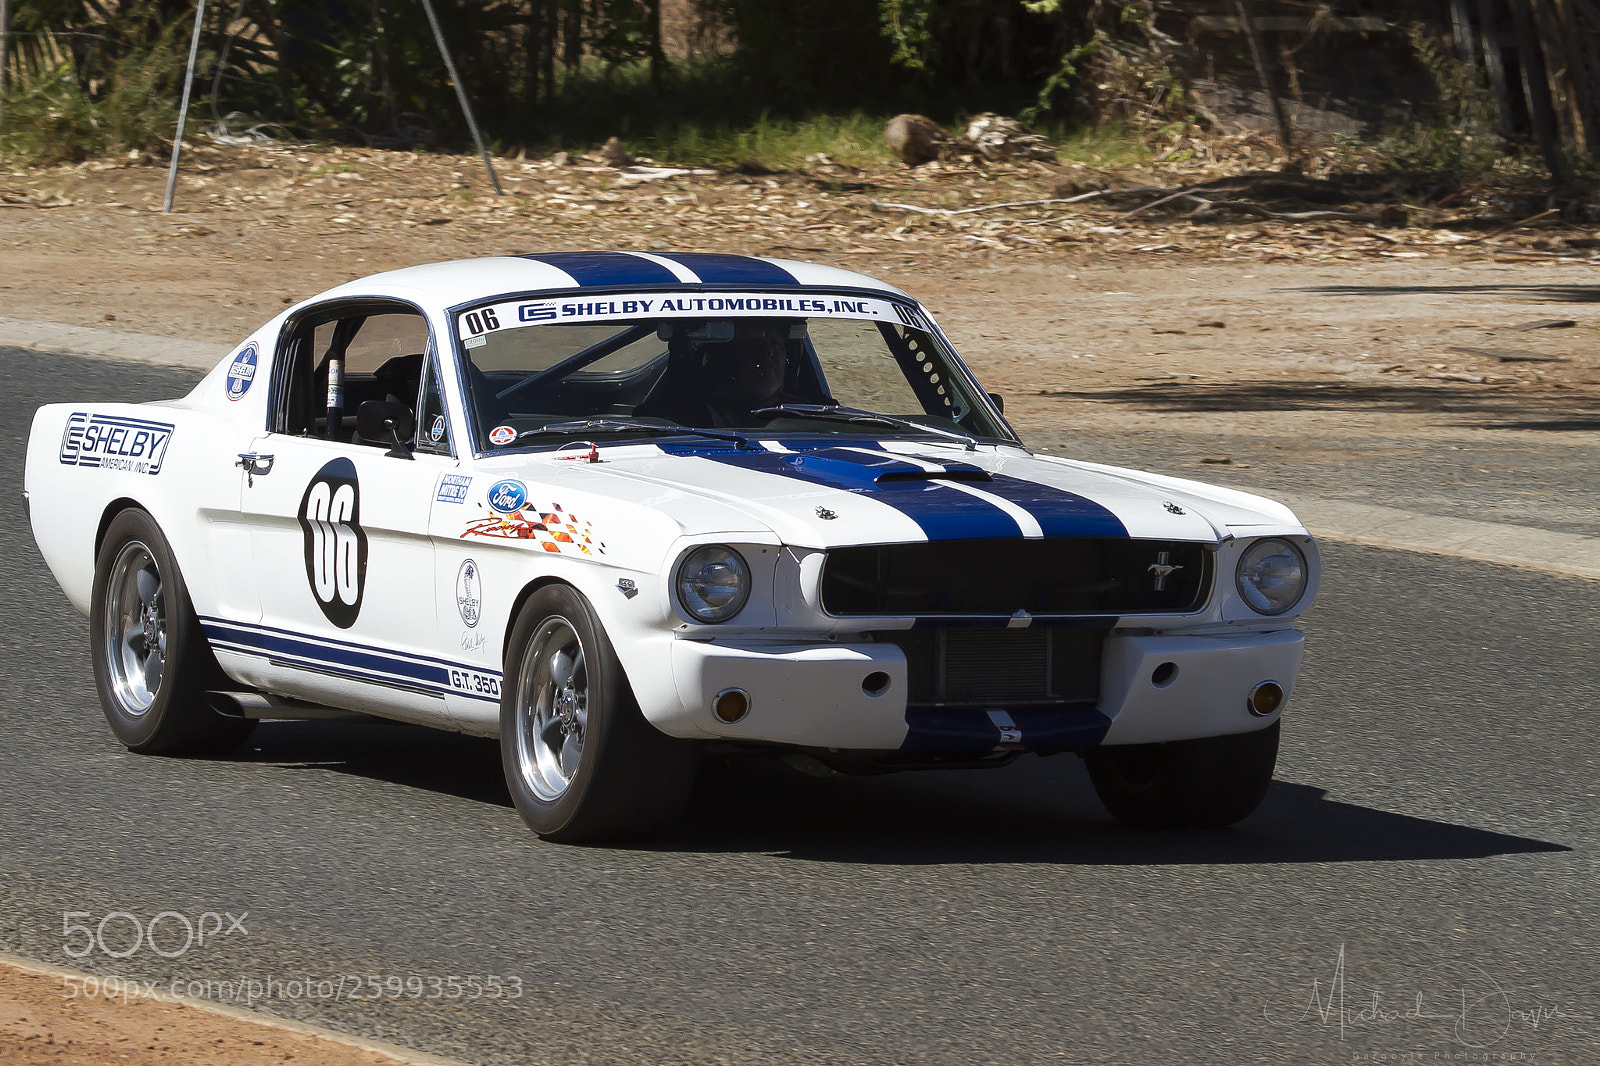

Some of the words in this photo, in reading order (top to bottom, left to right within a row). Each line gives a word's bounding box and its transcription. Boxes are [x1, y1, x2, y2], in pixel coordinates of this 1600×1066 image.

[561, 299, 654, 316] SHELBY
[465, 308, 500, 335] 06
[82, 425, 166, 459] SHELBY
[493, 484, 521, 509] Ford
[474, 674, 499, 695] 350
